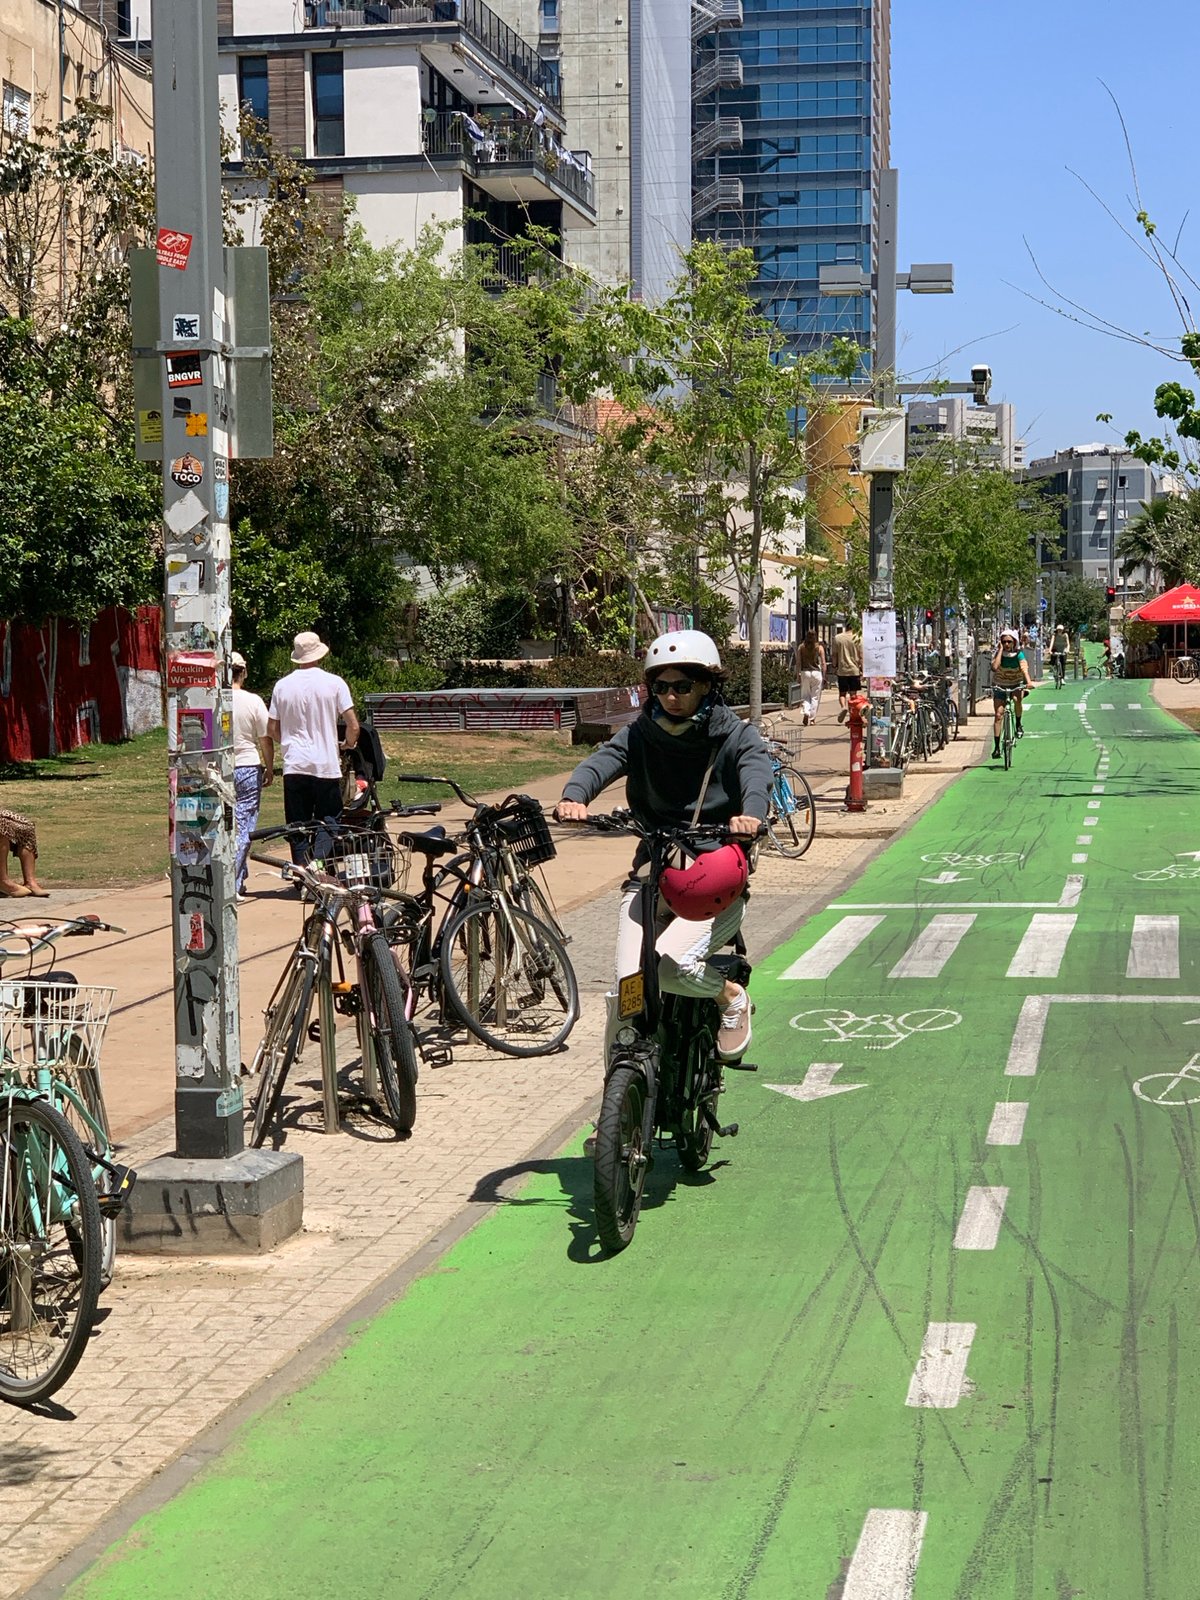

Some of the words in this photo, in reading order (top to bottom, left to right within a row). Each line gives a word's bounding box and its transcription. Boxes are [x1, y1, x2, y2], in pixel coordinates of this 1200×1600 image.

[168, 371, 201, 382] BNGVR
[173, 472, 201, 483] TOCO
[170, 665, 204, 674] Alkukin
[170, 676, 186, 684] We
[187, 675, 213, 684] Trust
[624, 980, 636, 997] AE
